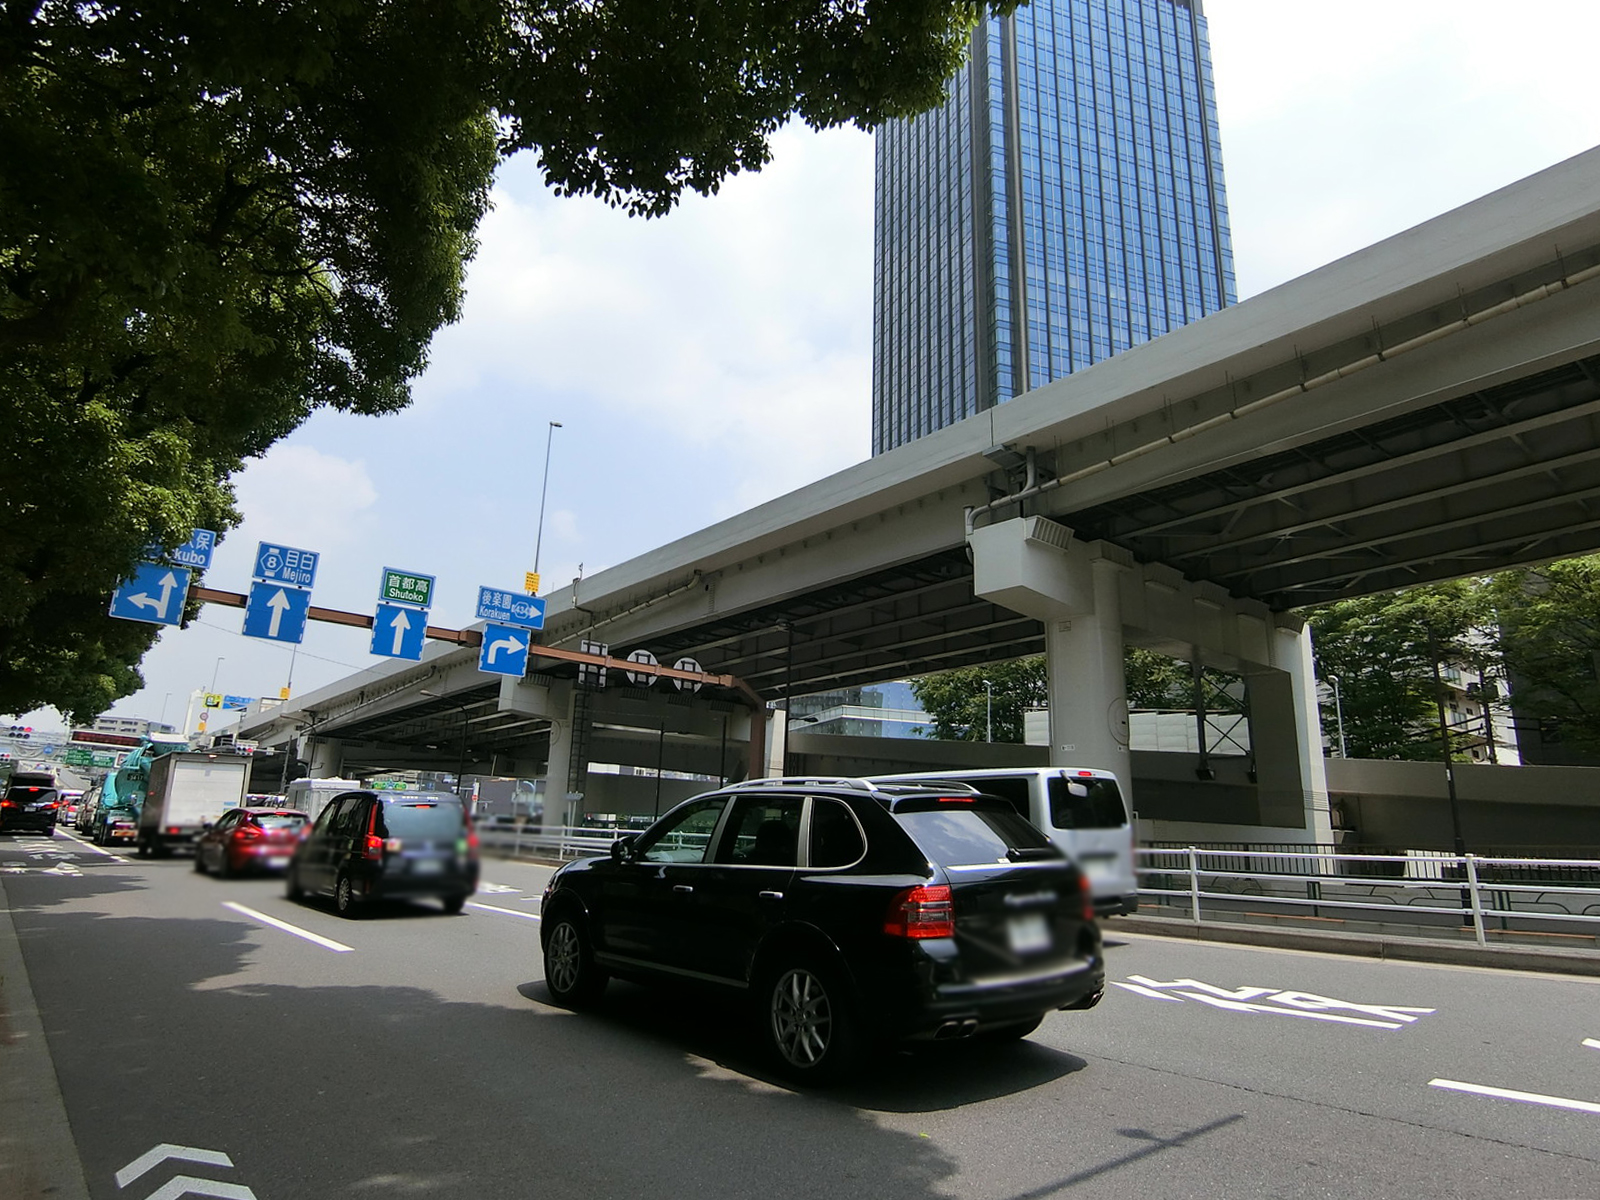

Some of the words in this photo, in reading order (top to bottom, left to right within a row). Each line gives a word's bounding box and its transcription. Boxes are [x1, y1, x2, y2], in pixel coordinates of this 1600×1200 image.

[268, 556, 277, 568] 8
[286, 549, 314, 571] 目白
[282, 566, 312, 584] Mejiro
[388, 575, 429, 594] 首都高
[389, 588, 424, 602] Shutoko
[482, 589, 513, 610] 後楽園
[479, 604, 511, 622] Korakuen
